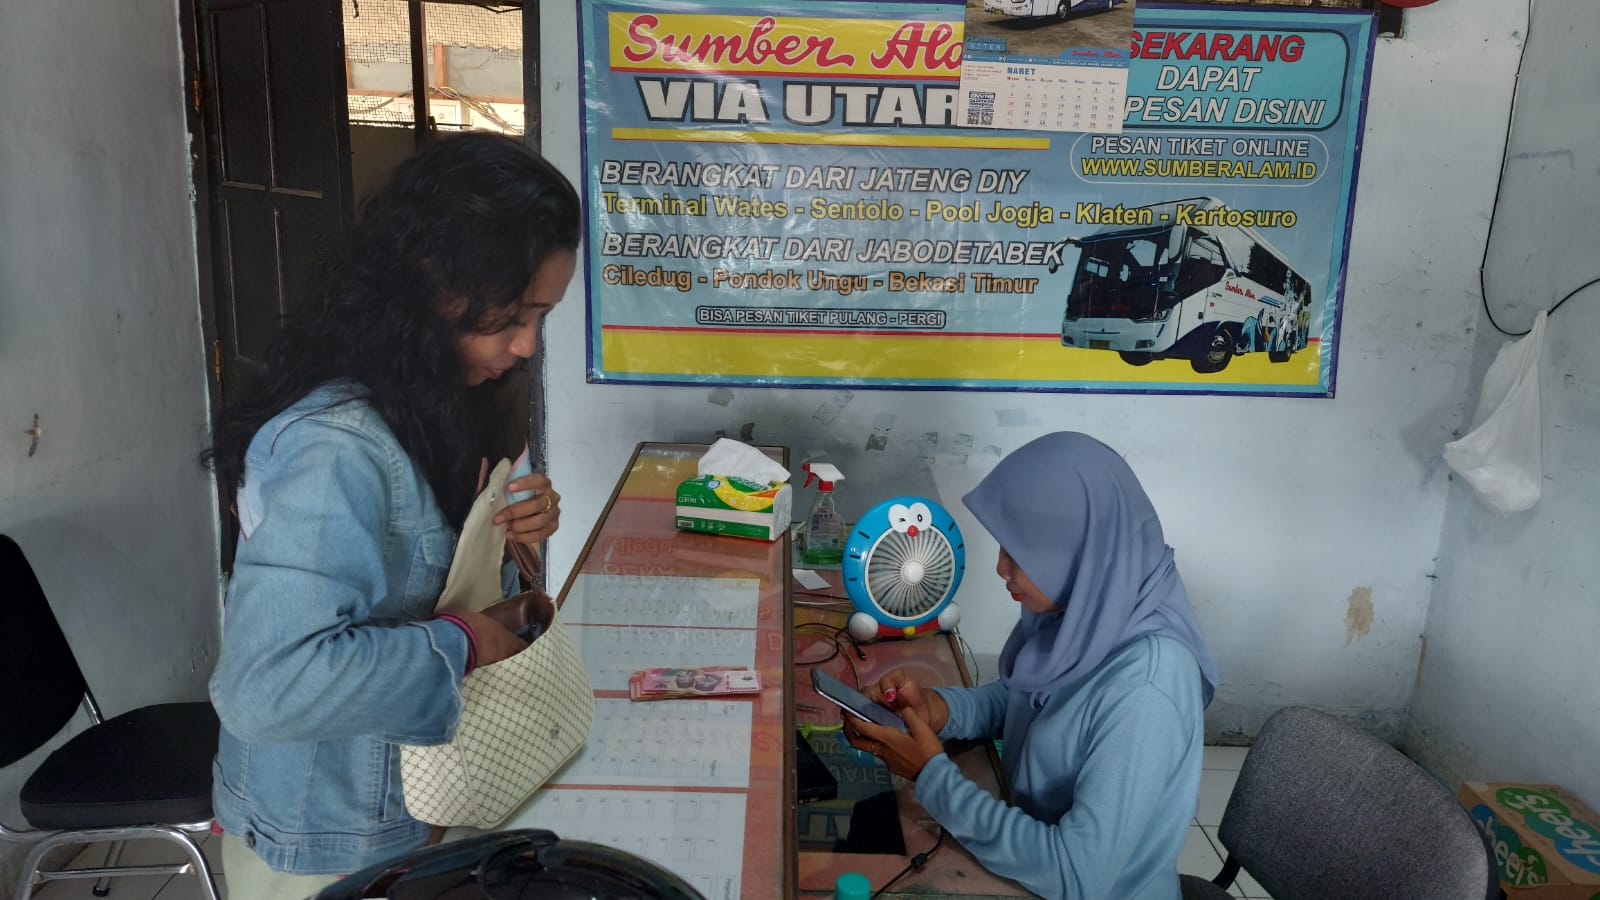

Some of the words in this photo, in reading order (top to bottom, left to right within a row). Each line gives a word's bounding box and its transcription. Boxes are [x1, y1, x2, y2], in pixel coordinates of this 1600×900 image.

[622, 13, 855, 67] Sumber
[1129, 30, 1306, 63] SEKARANG
[1157, 65, 1263, 93] DAPAT
[634, 76, 770, 124] VIA
[1122, 96, 1230, 123] PESAN
[1233, 99, 1325, 125] DISINI
[1091, 137, 1165, 154] PESAN
[1167, 138, 1228, 156] TIKET
[1232, 139, 1309, 157] ONLINE
[601, 160, 779, 189] BERANGKAT
[784, 165, 855, 191] DARI
[858, 167, 971, 193] JATENG
[977, 169, 1030, 194] DIY
[1081, 158, 1316, 179] WWW.SUMBERALAM.ID
[603, 192, 706, 217] Terminal
[712, 194, 788, 218] Wates
[809, 198, 903, 221] Sentolo
[925, 199, 980, 222] Pool
[987, 202, 1053, 229] Jogja
[1076, 202, 1153, 226] Klaten
[1175, 204, 1297, 228] Kartosuro
[601, 231, 779, 260] BERANGKAT
[783, 237, 853, 262] DARI
[856, 239, 1066, 266] JABODETABEK
[602, 264, 692, 292] Ciledug
[712, 267, 801, 290] Pondok
[806, 270, 867, 296] Ungu
[888, 272, 966, 293] Bekasi
[971, 273, 1040, 294] Timur
[700, 309, 733, 322] BISA
[735, 310, 783, 323] PESAN
[786, 311, 827, 324] TIKET
[829, 312, 887, 325] PULANG
[898, 313, 942, 326] PERGI
